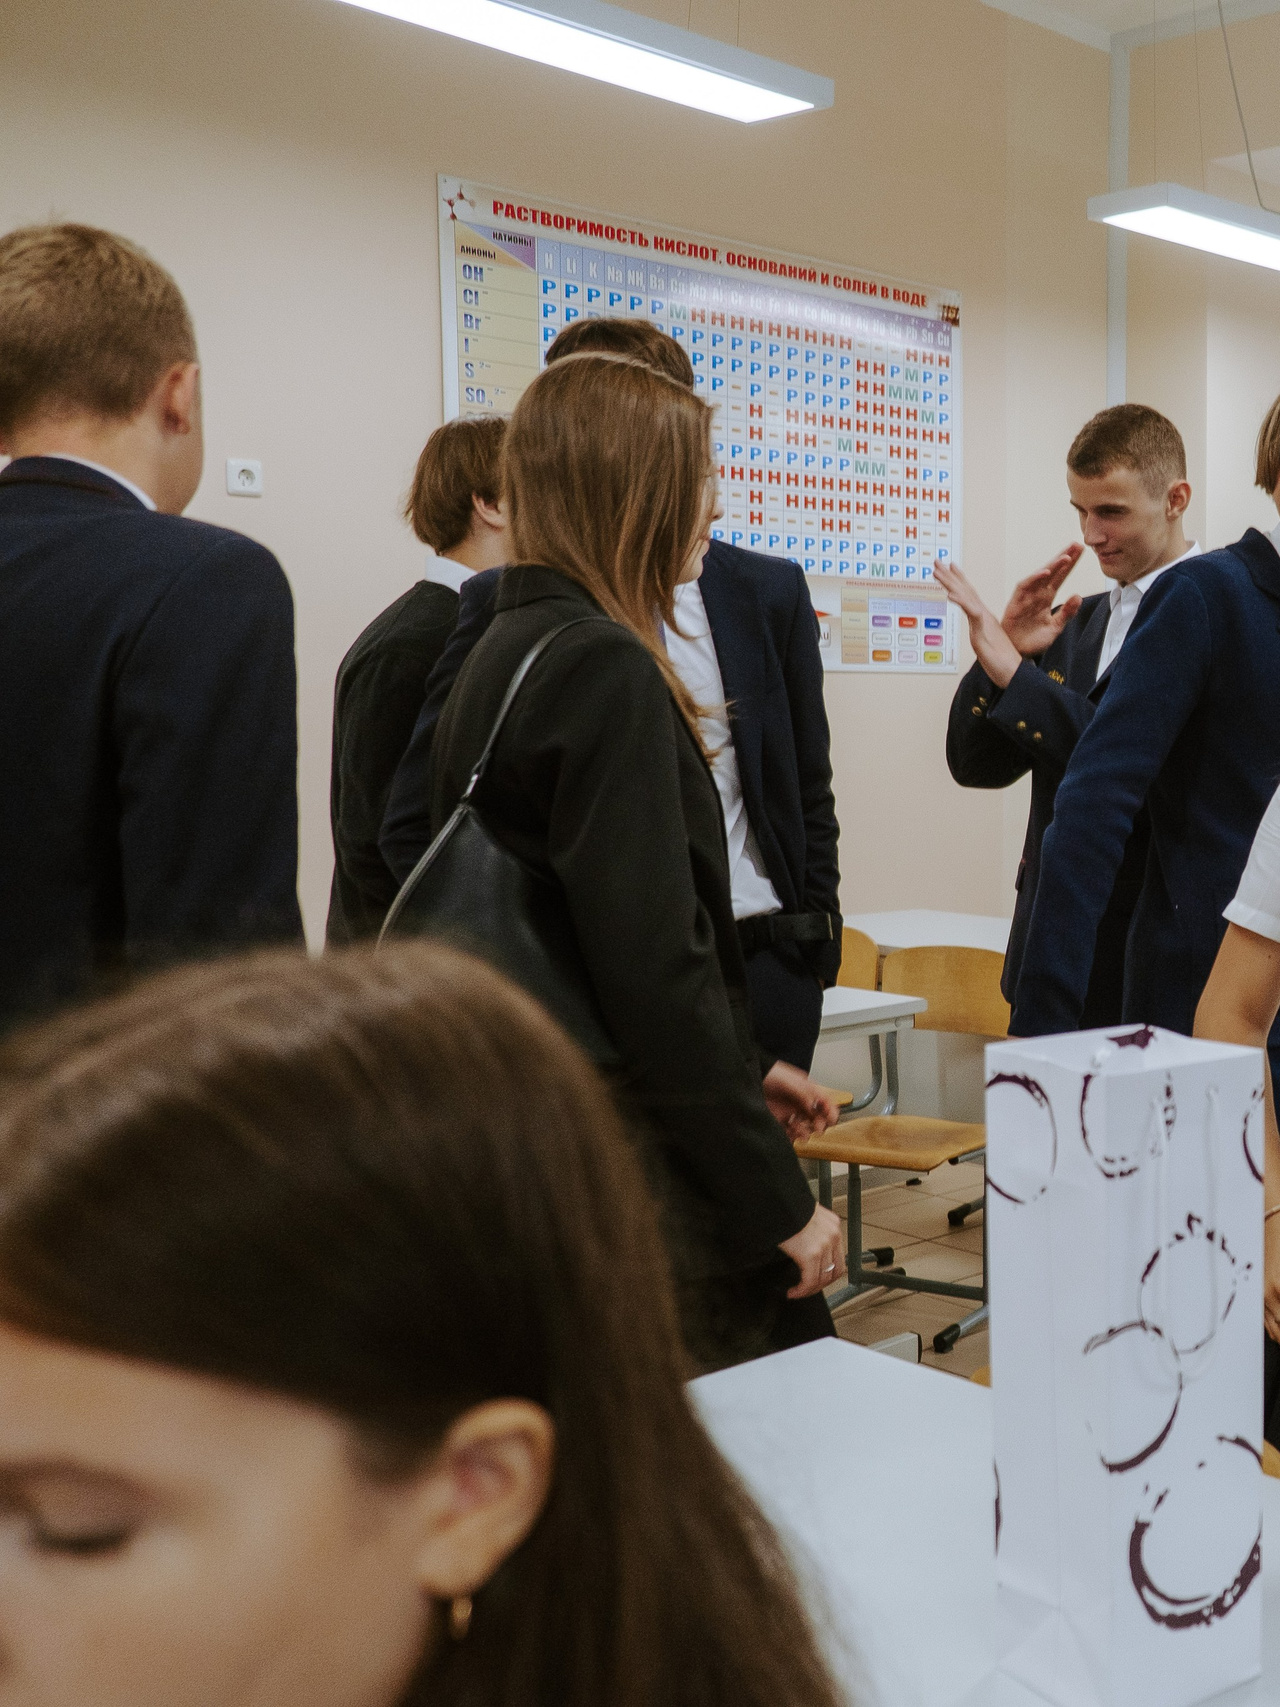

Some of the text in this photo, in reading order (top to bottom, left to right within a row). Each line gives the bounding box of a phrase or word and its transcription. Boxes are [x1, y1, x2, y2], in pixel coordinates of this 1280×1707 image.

[460, 245, 496, 260] АНИОНЫ
[492, 231, 532, 248] КАТИОНЫ
[493, 200, 649, 248] РАСТВОРИМОСТЬ
[726, 251, 817, 283] ОСНОВАНИЙ
[820, 272, 830, 286] И
[833, 275, 878, 296] СОЛЕЙ
[880, 286, 889, 299] В
[892, 289, 927, 308] ВОДЕ
[542, 279, 949, 367] Р Р Р Р Р Р Н Н Н
[542, 302, 557, 318] Р
[564, 307, 579, 322] Р
[692, 329, 704, 344] Р
[712, 333, 724, 347] Р
[731, 336, 743, 350] Р
[750, 340, 762, 354] Р
[768, 343, 780, 356] Р
[787, 346, 798, 360] Р
[805, 350, 816, 362] Р
[822, 353, 833, 366] Р
[840, 356, 850, 368] Р
[856, 360, 868, 372] Н
[873, 362, 884, 375] Н
[890, 364, 900, 377] Р
[922, 370, 932, 383] Р
[939, 373, 948, 386] Р
[542, 327, 557, 342] Р
[692, 351, 704, 366] Р
[712, 354, 724, 369] Р
[731, 358, 743, 372] Р
[750, 361, 762, 375] Р
[768, 365, 780, 378] Р
[787, 368, 798, 381] Р
[804, 371, 816, 384] Р
[822, 373, 833, 386] Р
[840, 376, 850, 389] Р
[856, 380, 868, 392] Н
[873, 383, 885, 395] Н
[922, 390, 932, 402] Р
[939, 394, 948, 404] Р
[711, 376, 724, 391] Р
[750, 383, 762, 396] Р
[786, 388, 798, 402] Р
[804, 391, 816, 404] Р
[822, 394, 833, 408] Р
[839, 397, 850, 410] Р
[856, 400, 868, 413] Н
[873, 403, 884, 415] Н
[890, 406, 900, 417] Н
[906, 408, 917, 420] Н
[938, 412, 948, 424] Р
[749, 404, 950, 444] Н Н Н Н Н Н Н Н Н
[749, 426, 917, 459] Н Н Н Н
[730, 444, 743, 458] Р
[750, 446, 761, 460] Р
[768, 449, 780, 462] Р
[786, 451, 798, 464] Р
[804, 454, 815, 467] Р
[822, 456, 832, 469] Р
[839, 458, 850, 470] Р
[906, 467, 917, 479] Н
[922, 468, 932, 480] Р
[939, 470, 948, 482] Р
[730, 466, 949, 502] Н Н Н Н Н Н Н Н Н Н Н Н Н
[749, 490, 949, 522] Н Н Н Н Н Н Н Н Н
[750, 511, 917, 538] Н Н Н Н
[750, 532, 948, 559] Р Р Р Р Р Р Р Р Р Р Р
[804, 558, 815, 571] Р
[822, 559, 832, 573] Р
[839, 561, 850, 574] Р
[856, 562, 867, 575] Р
[889, 564, 899, 576] Р
[906, 565, 916, 578] Р
[922, 566, 932, 580] Р
